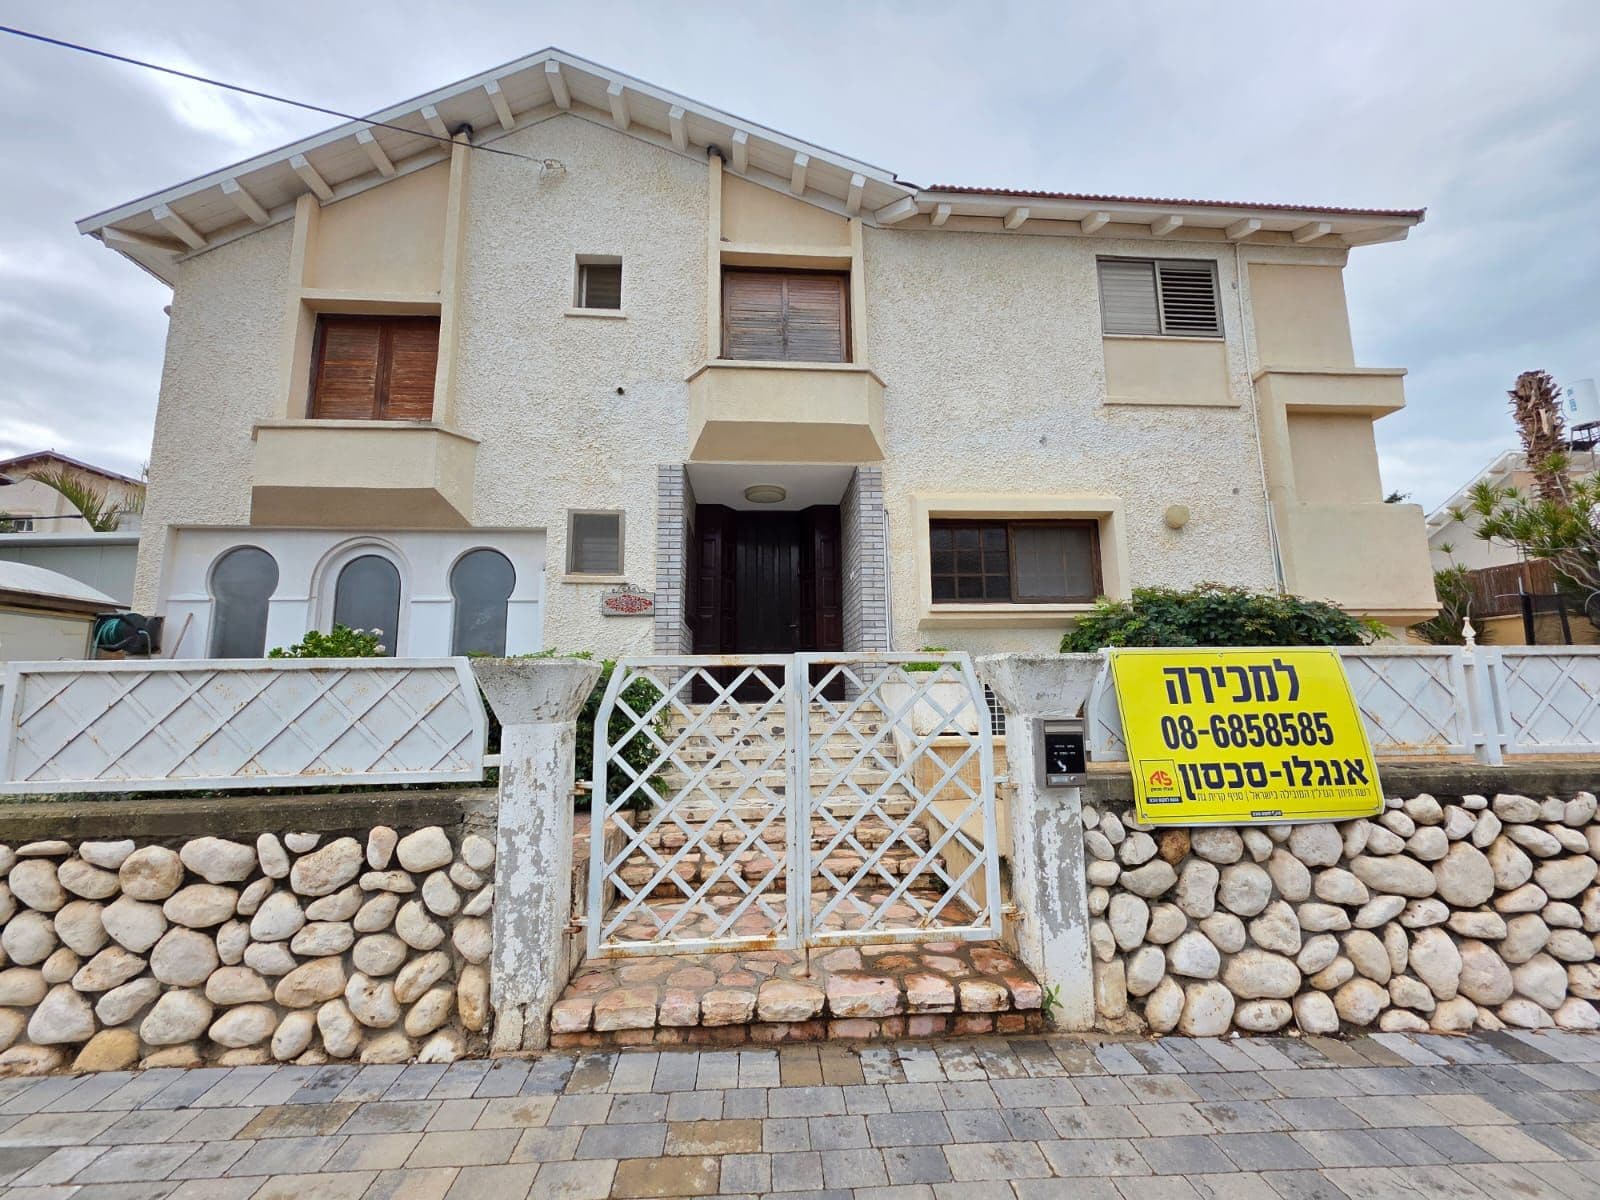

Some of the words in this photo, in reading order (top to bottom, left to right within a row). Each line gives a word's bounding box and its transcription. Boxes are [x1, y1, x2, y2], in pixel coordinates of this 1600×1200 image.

[1163, 658, 1300, 704] למכירה
[1161, 712, 1334, 750] 08-6858585
[1150, 770, 1172, 786] AS
[1178, 756, 1369, 800] אנגלו-סכסון
